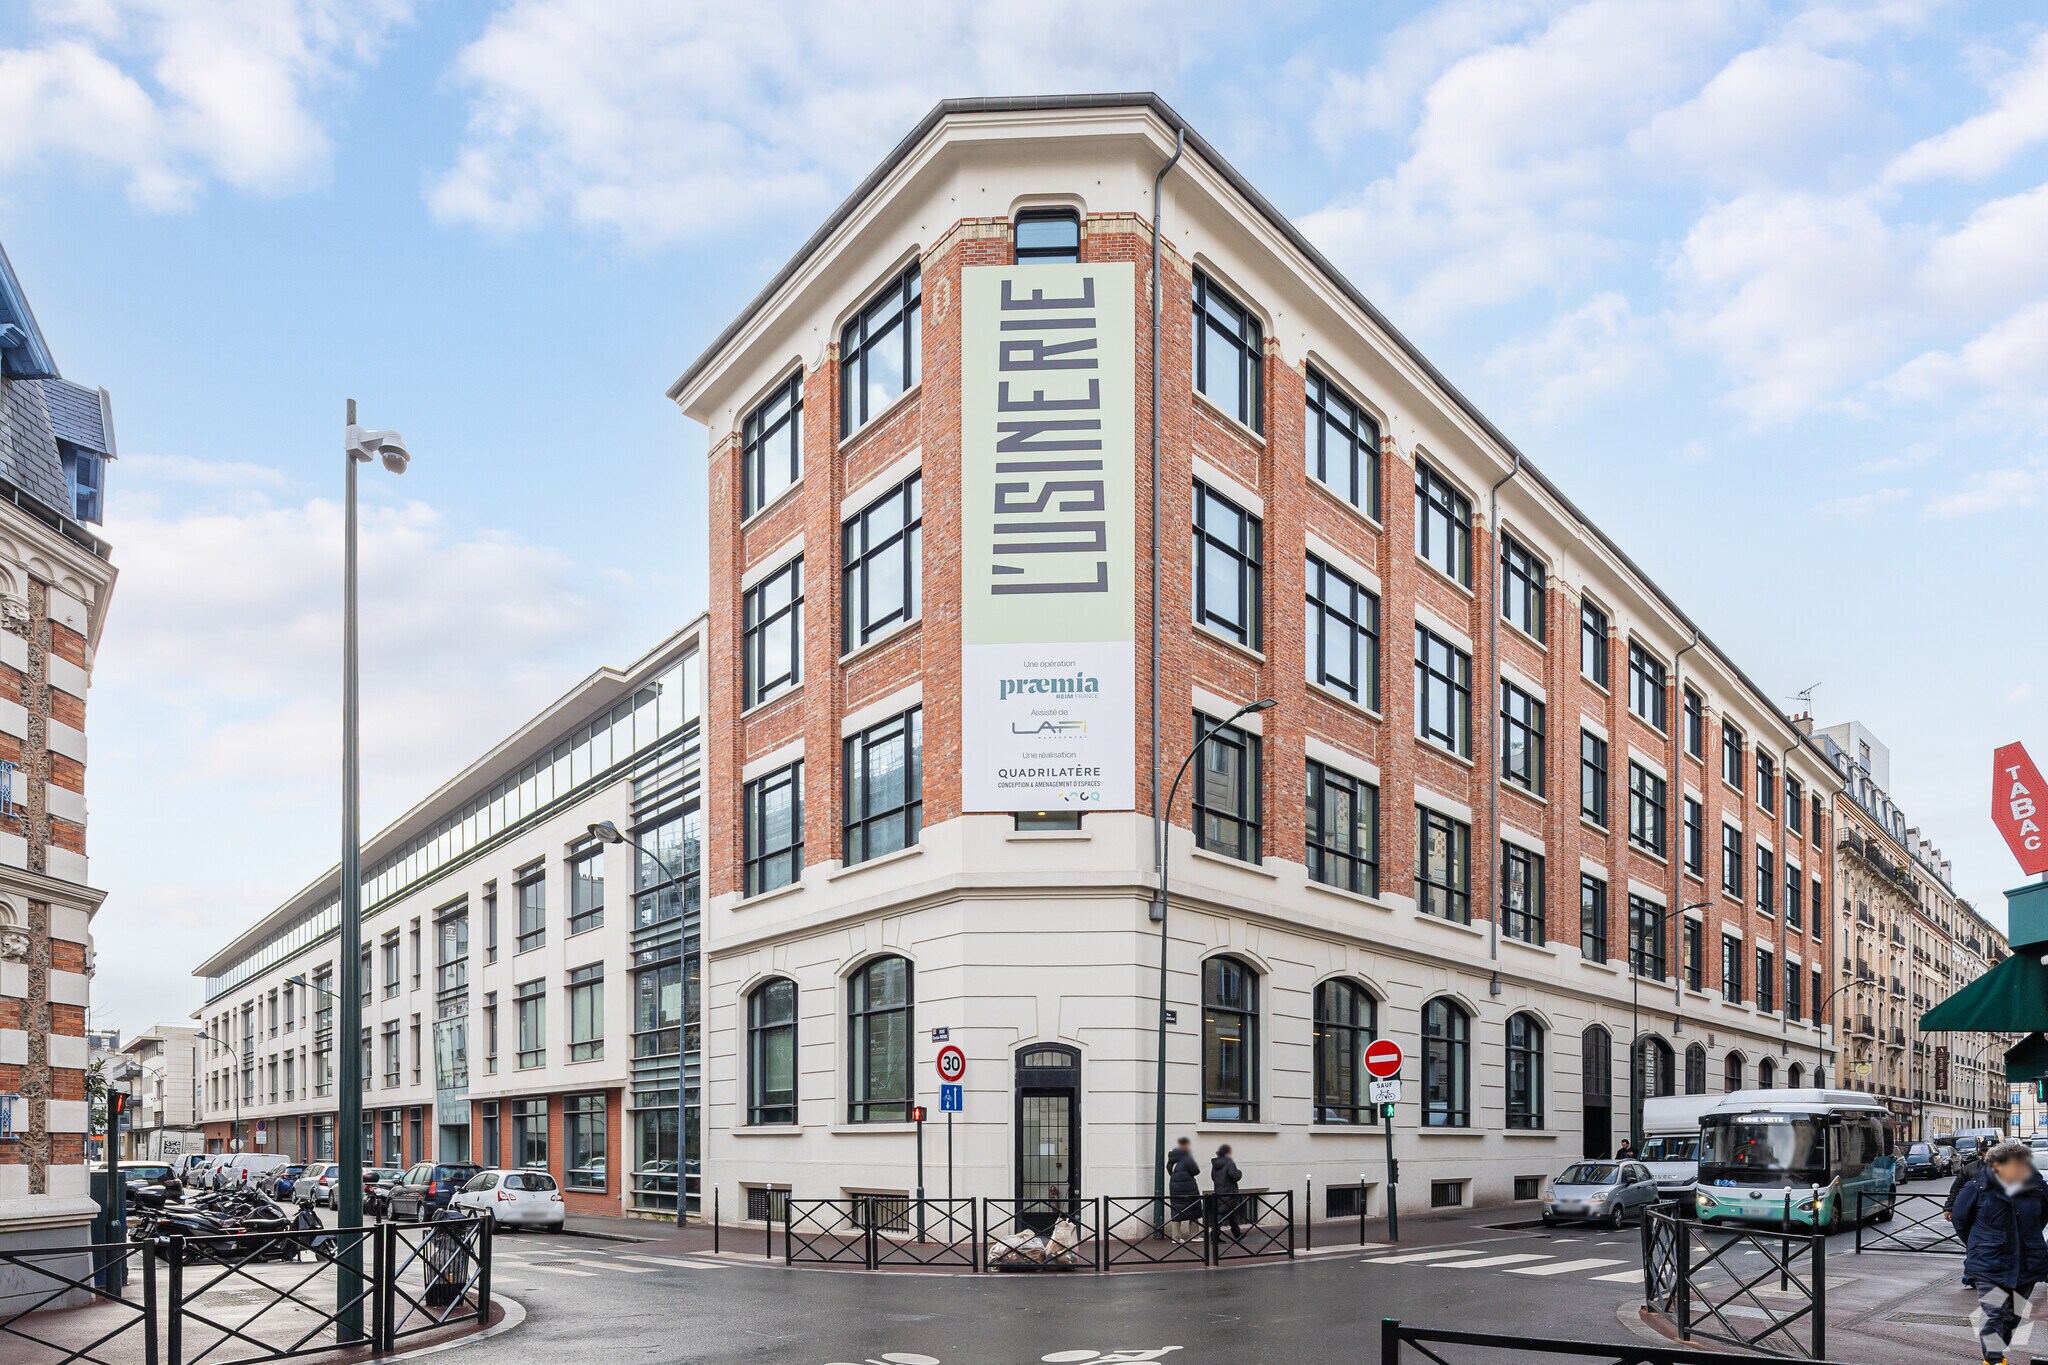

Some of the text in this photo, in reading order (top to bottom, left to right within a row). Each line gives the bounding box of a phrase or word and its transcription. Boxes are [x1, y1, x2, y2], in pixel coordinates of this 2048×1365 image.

[991, 277, 1108, 595] L'USINERIE
[1023, 660, 1076, 669] Une opération
[999, 671, 1099, 700] præmia
[1030, 708, 1069, 716] Assisté de
[1038, 751, 1077, 759] réalisation
[998, 763, 1101, 779] QUADRILATÈRE
[997, 781, 1030, 789] CONCEPTION
[2005, 765, 2042, 851] TABAC
[943, 1056, 960, 1071] 30
